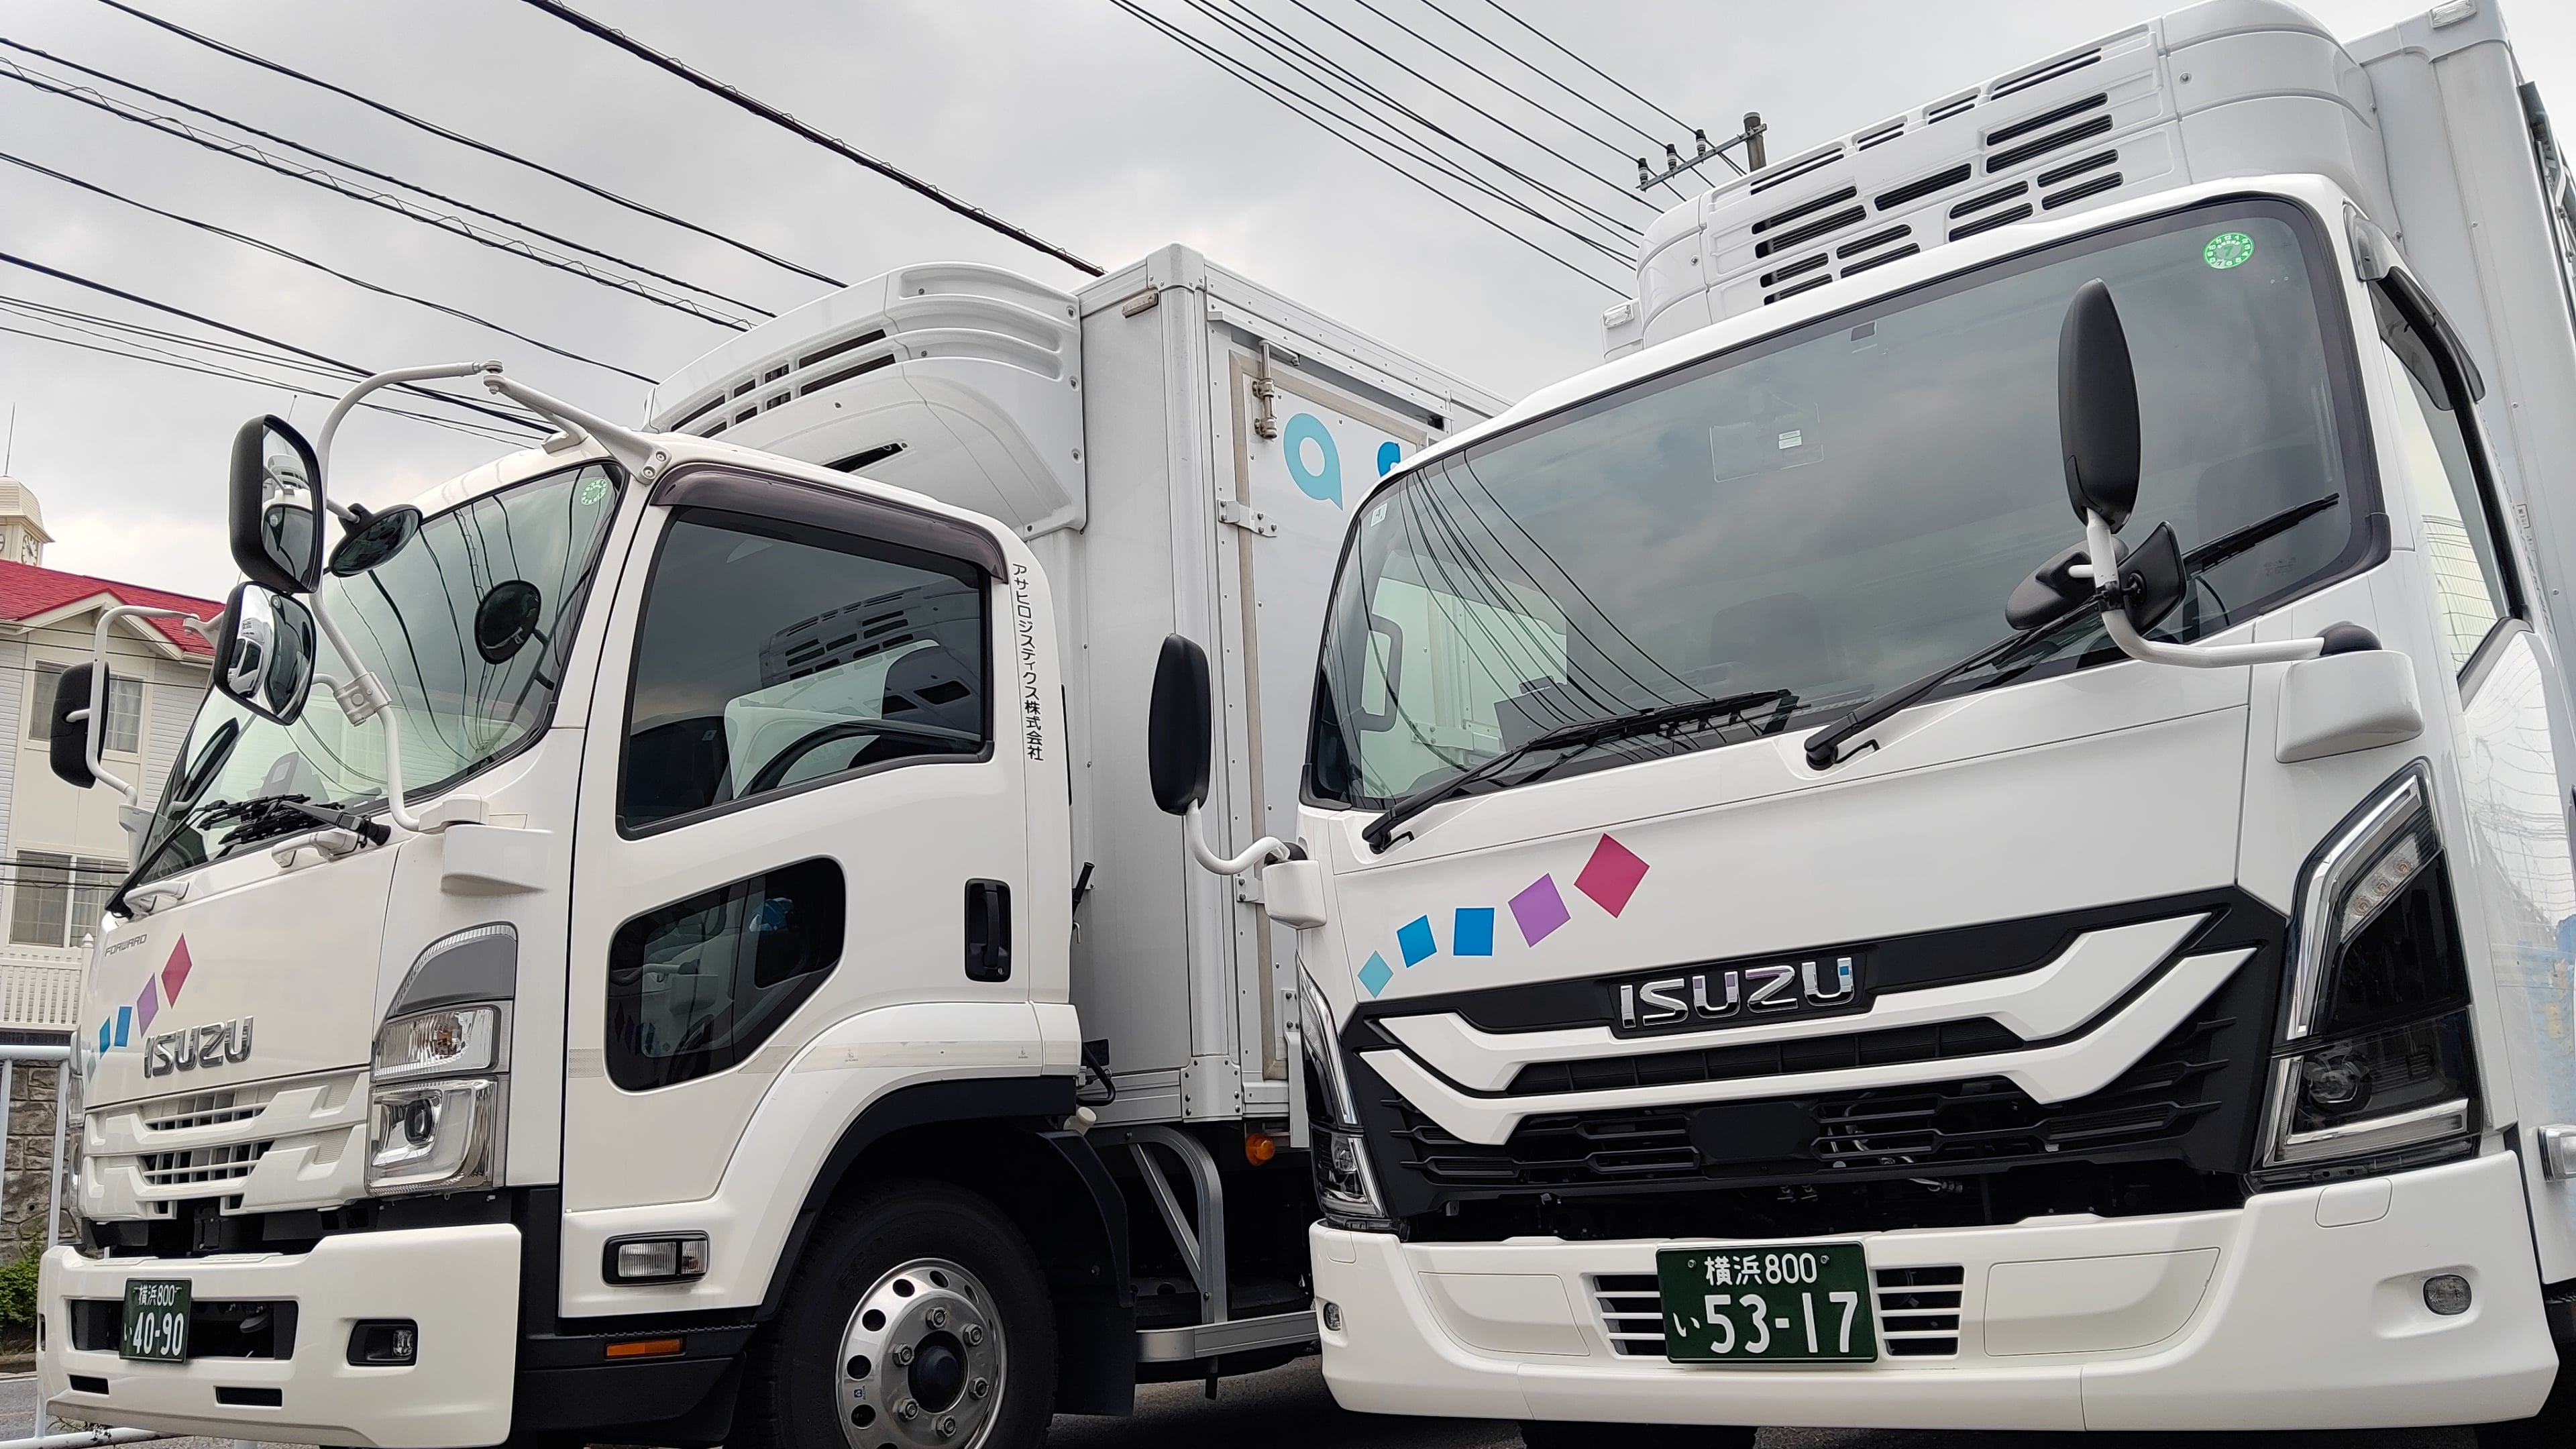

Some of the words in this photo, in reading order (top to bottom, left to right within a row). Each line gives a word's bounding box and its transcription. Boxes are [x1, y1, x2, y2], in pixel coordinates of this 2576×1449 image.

[1012, 563, 1044, 761] アサヒロジスティクス株式会社
[105, 934, 148, 957] FORWARD
[1620, 957, 1854, 1028] ISUZU
[144, 1015, 254, 1079] ISUZU
[133, 1312, 184, 1356] 40-90
[1704, 1291, 1858, 1354] 53-17
